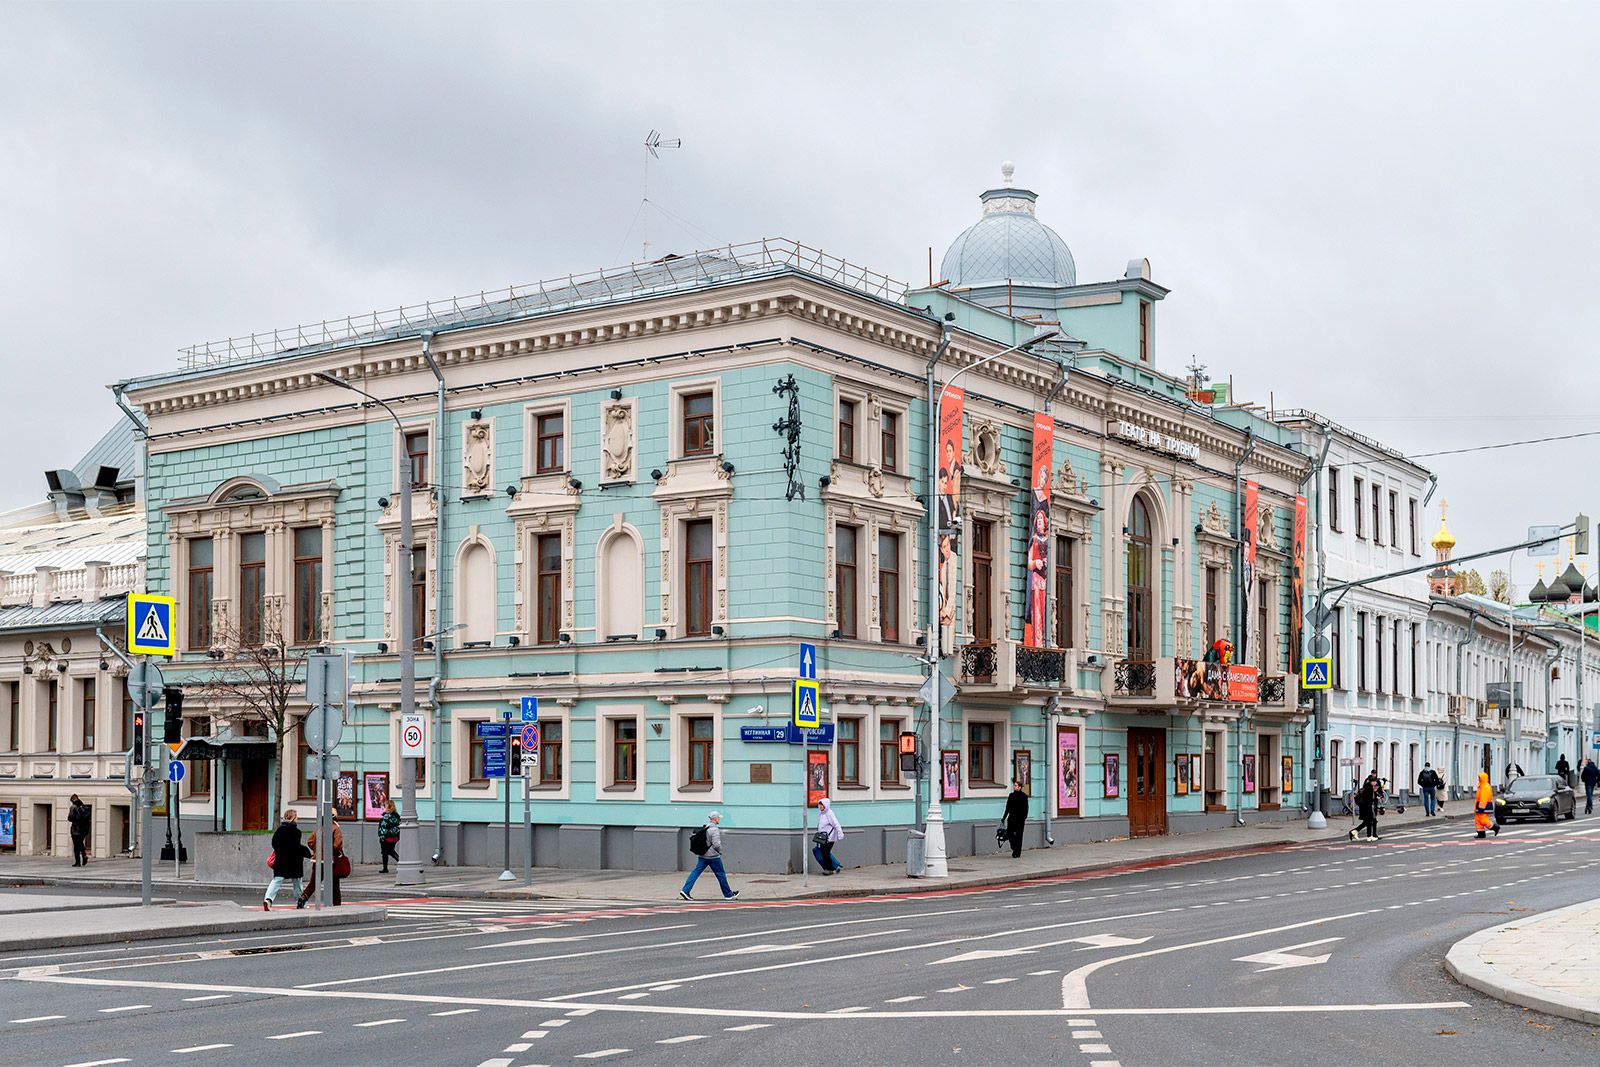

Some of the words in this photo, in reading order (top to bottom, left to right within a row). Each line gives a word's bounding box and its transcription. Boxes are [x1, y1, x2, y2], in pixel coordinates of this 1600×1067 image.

[1120, 422, 1146, 439] ТЕАТР
[1148, 431, 1160, 446] НА
[1166, 437, 1200, 458] ТРУБНОЙ
[1208, 670, 1221, 680] ДАМА
[1222, 672, 1227, 681] С
[408, 732, 418, 740] 50
